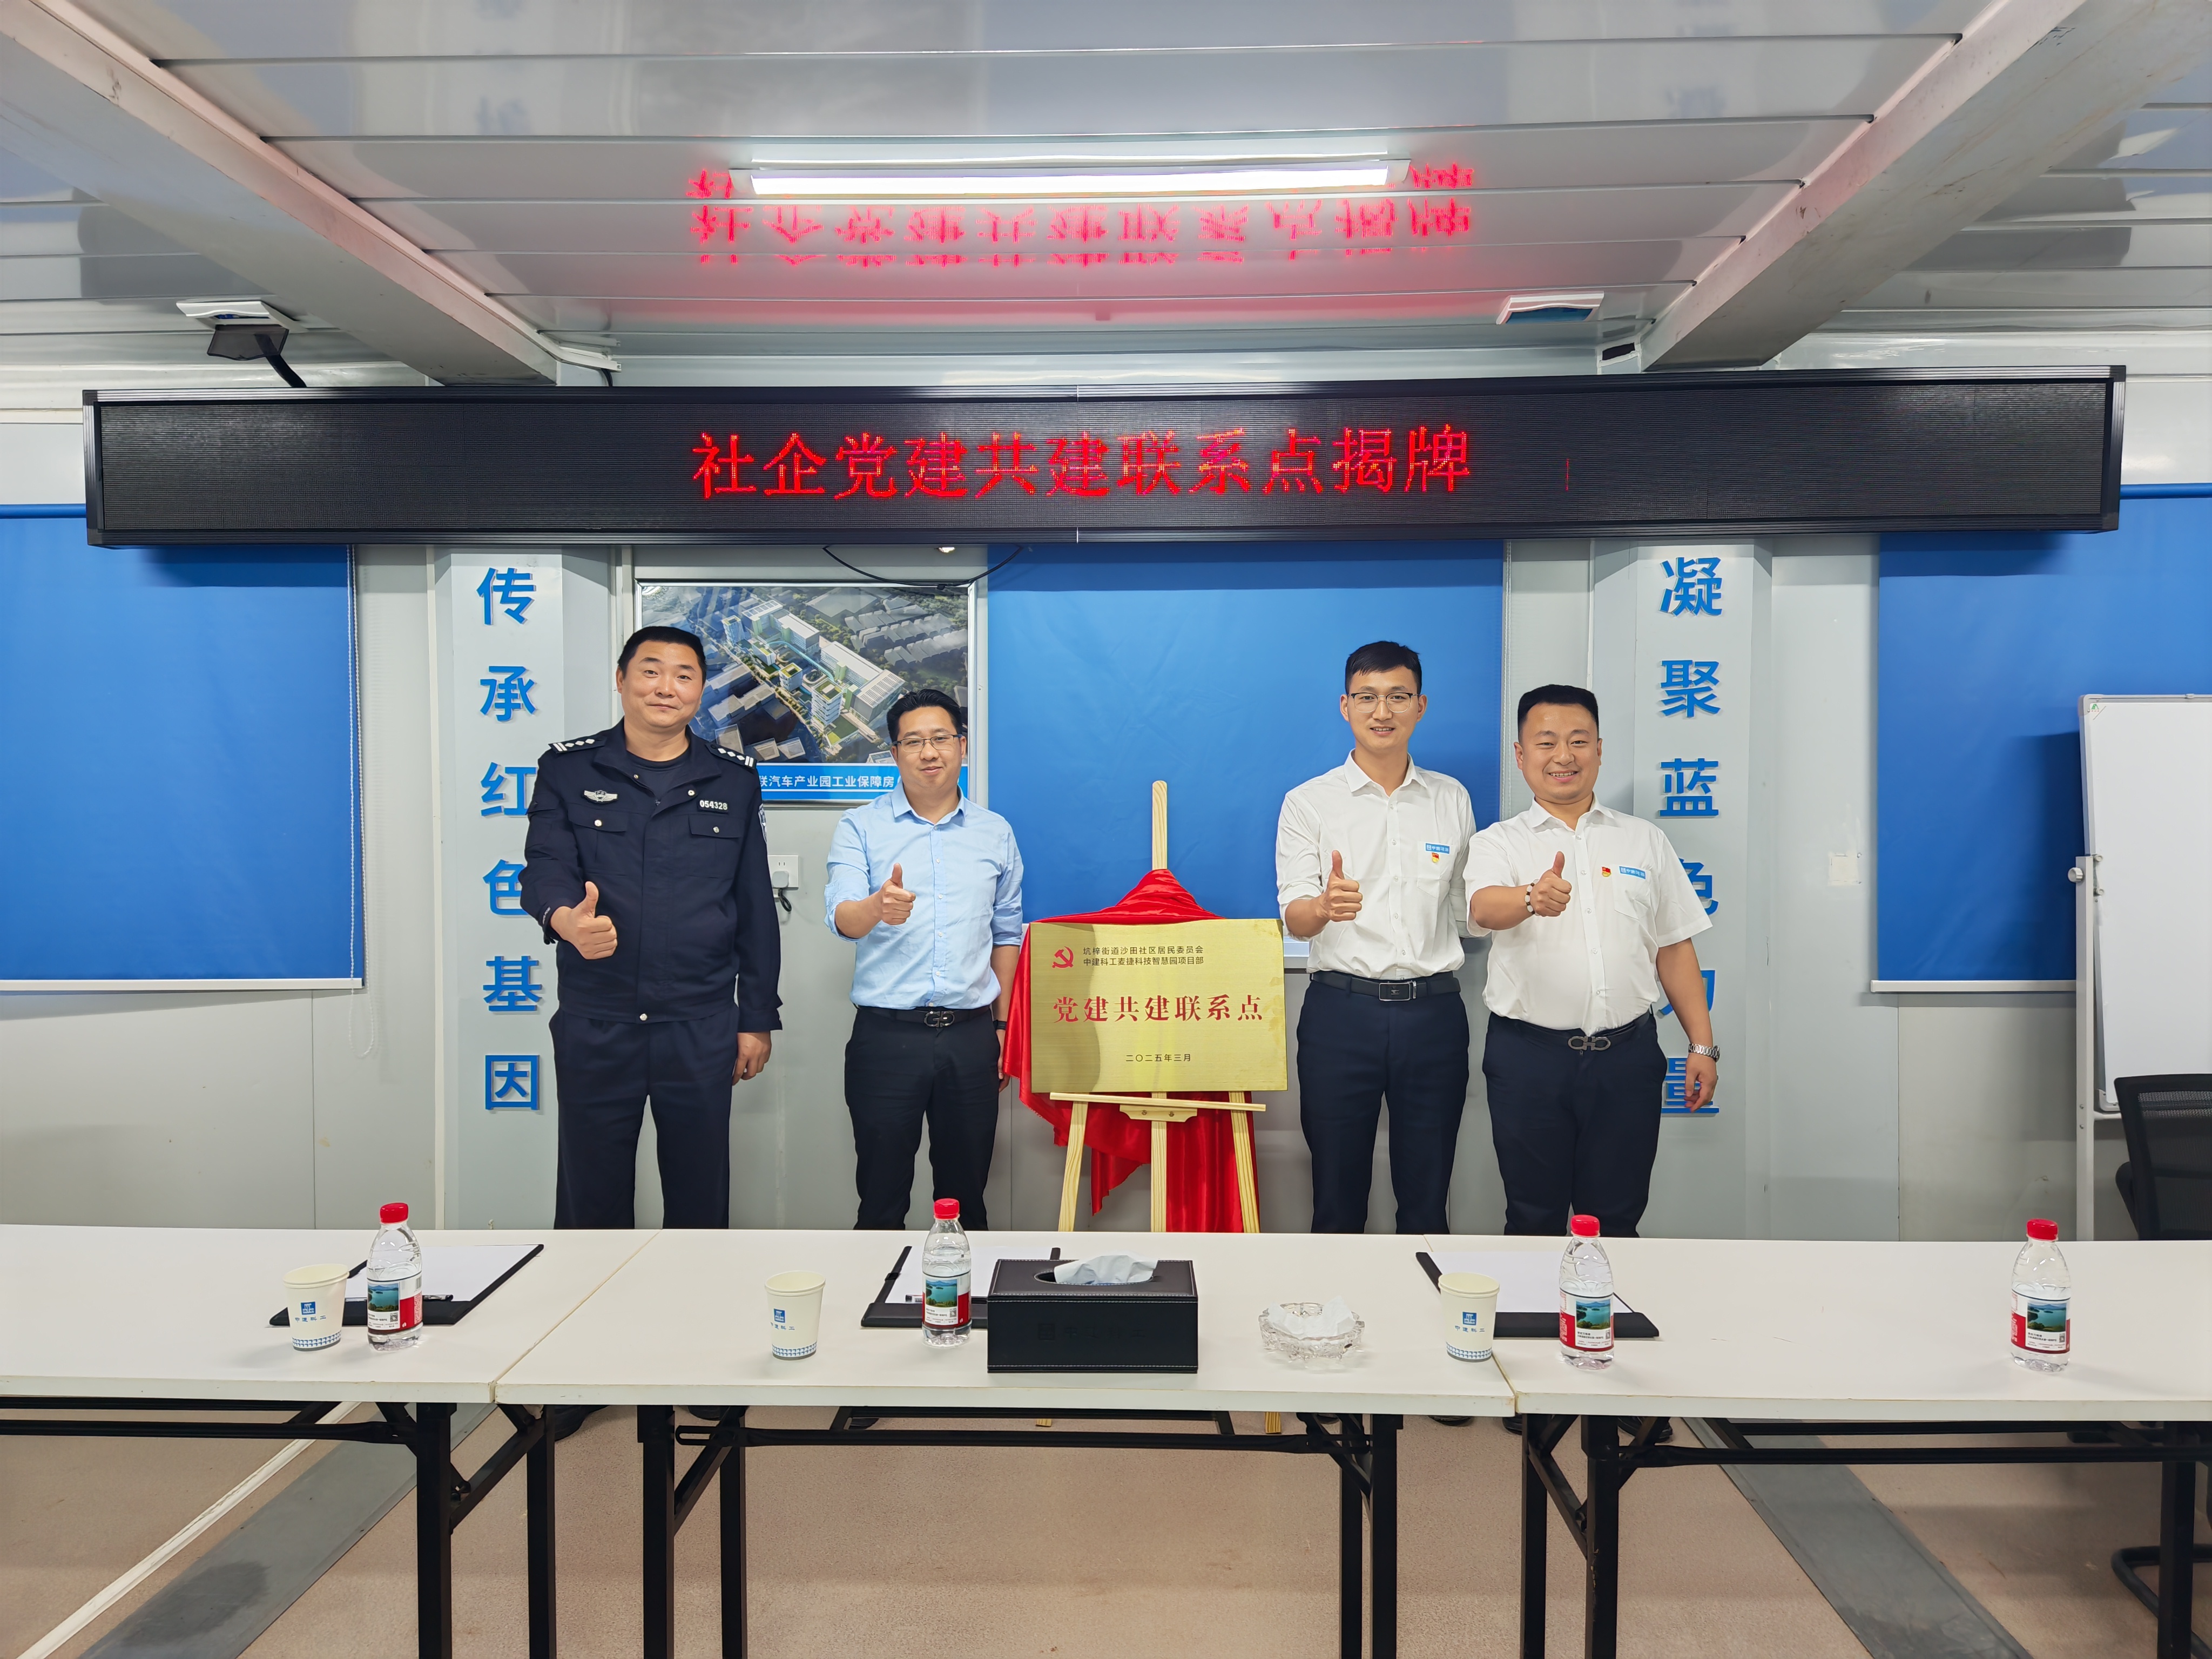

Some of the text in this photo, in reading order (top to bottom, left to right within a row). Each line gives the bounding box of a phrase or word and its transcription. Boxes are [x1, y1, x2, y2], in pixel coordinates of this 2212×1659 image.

[692, 424, 1471, 500] 社企党建共建联系点揭牌
[700, 800, 727, 810] 054328
[477, 568, 542, 1110] 传承红色基因
[1083, 945, 1204, 955] 坑梓街道沙田社区居民委员会
[1083, 956, 1204, 966] 中建科工麦捷科技智慧园项目部
[1053, 994, 1263, 1023] 党建共建联系点
